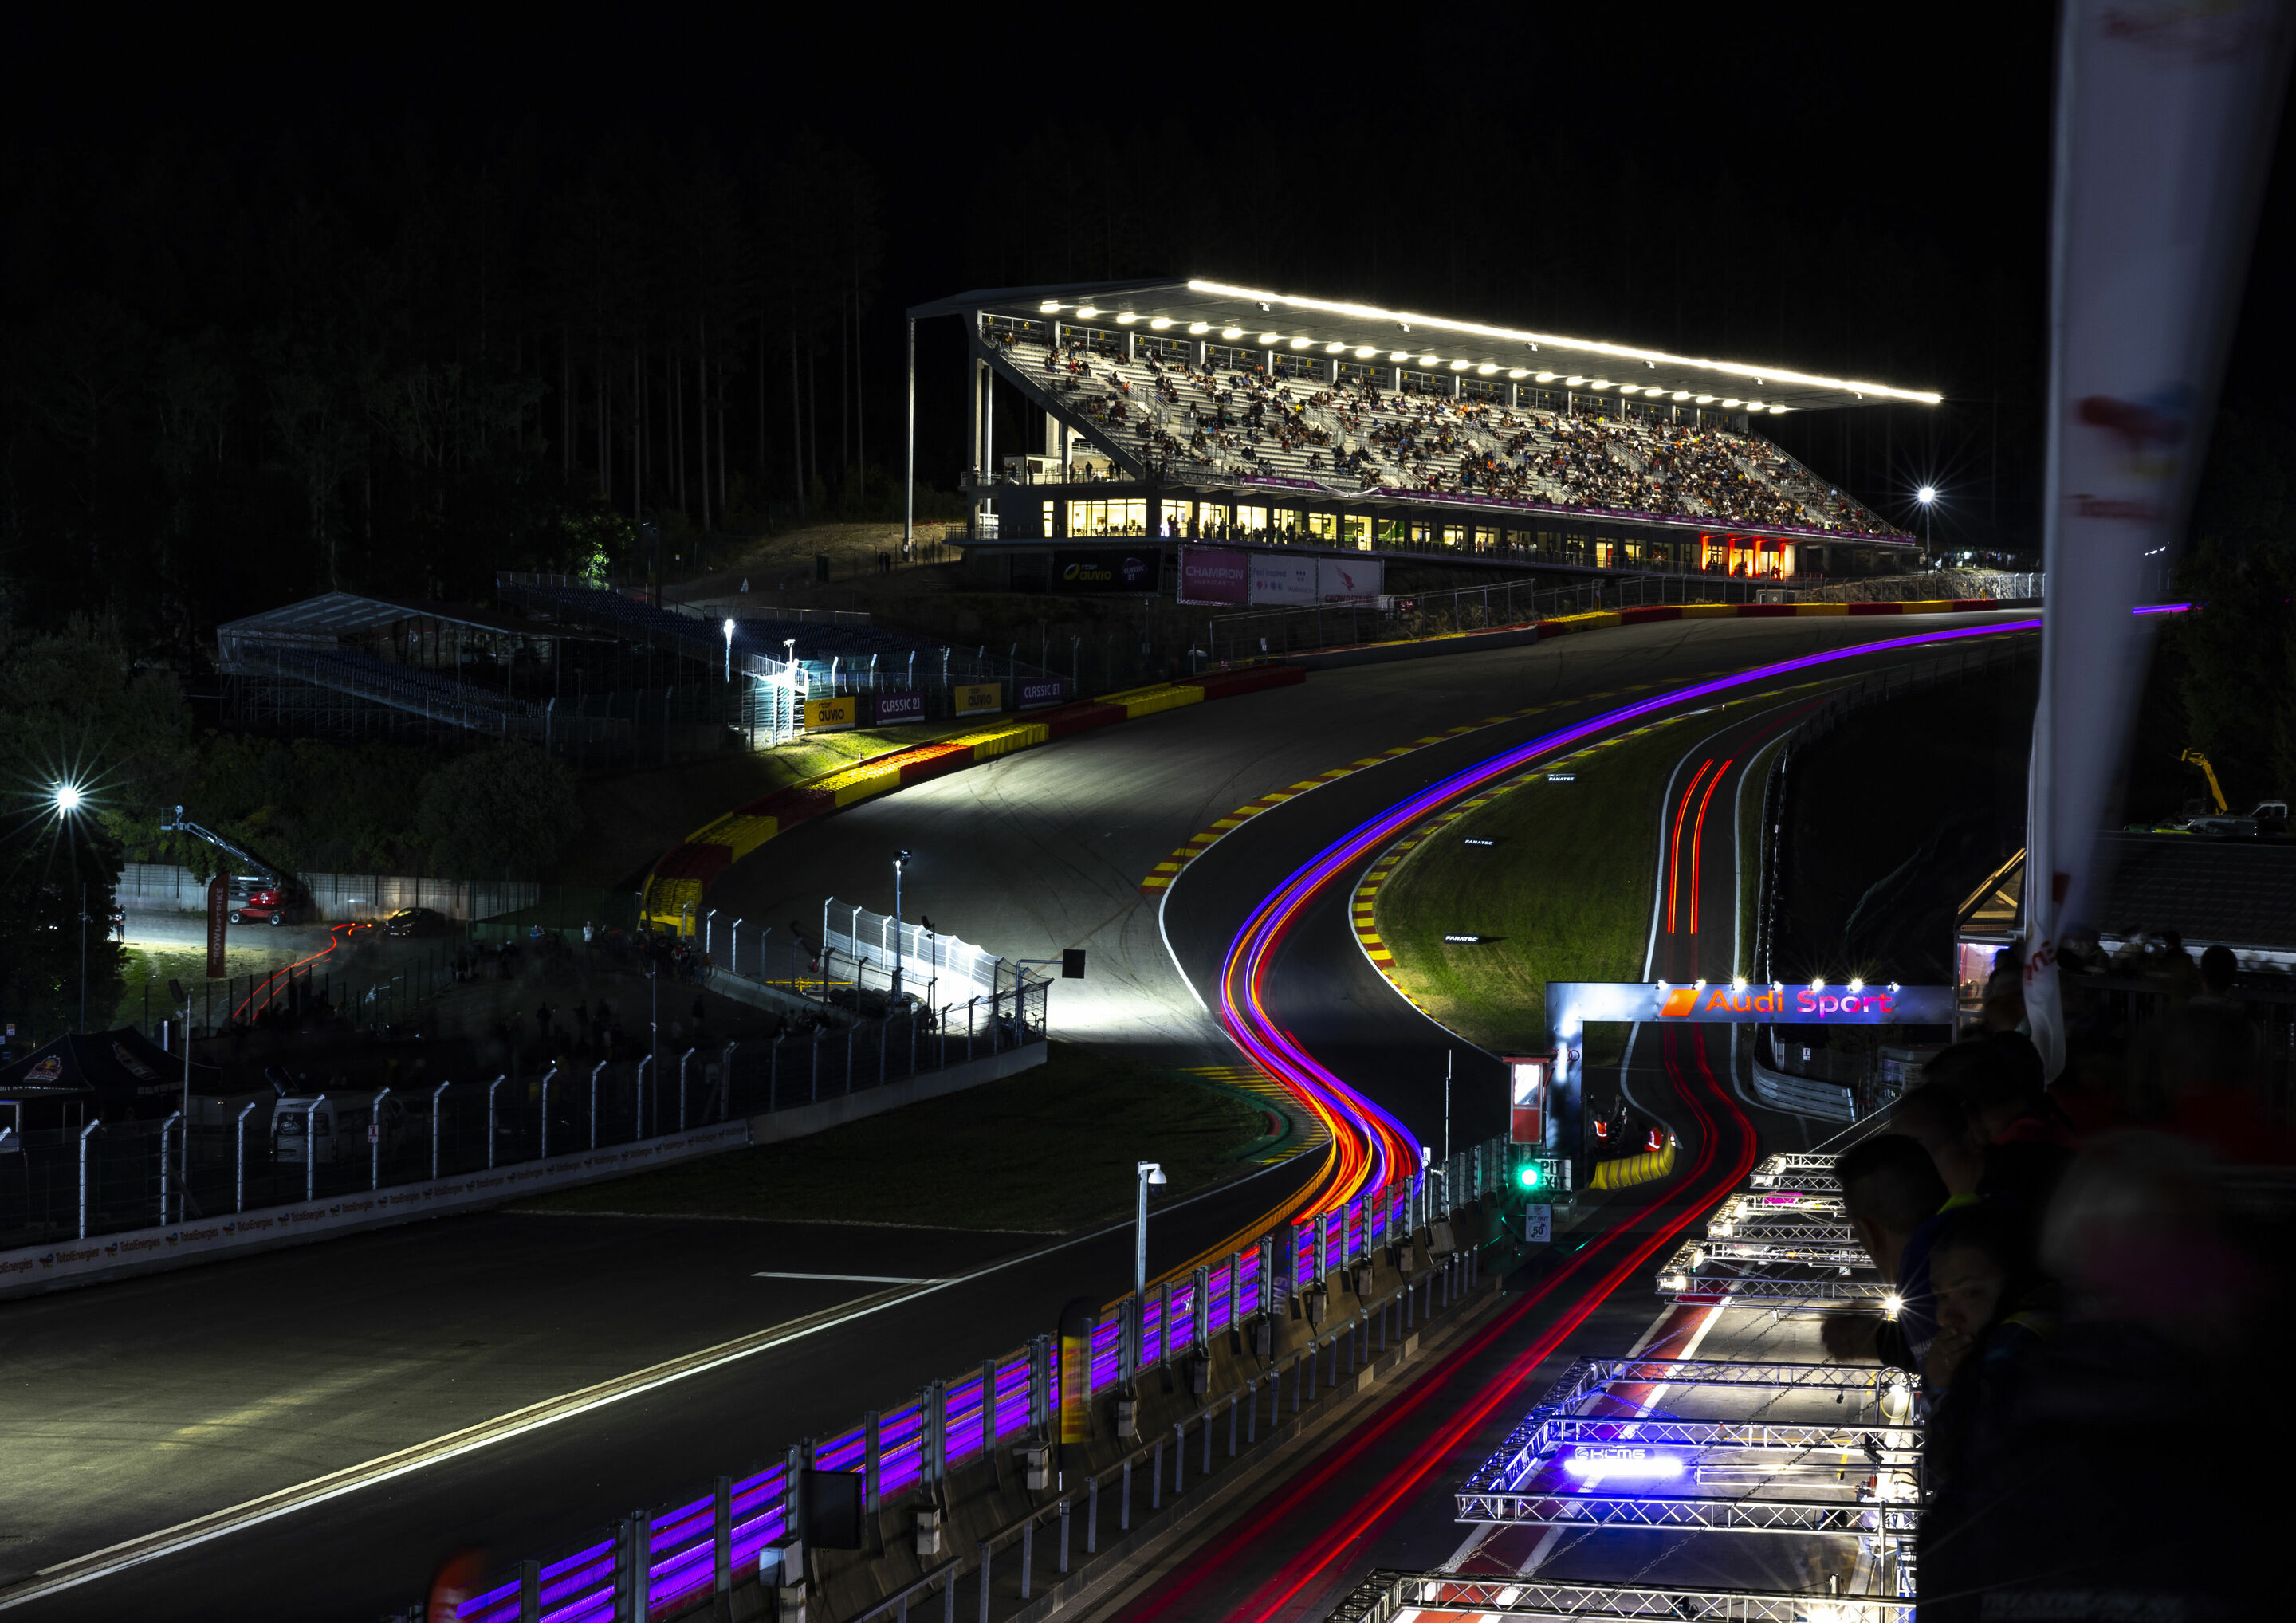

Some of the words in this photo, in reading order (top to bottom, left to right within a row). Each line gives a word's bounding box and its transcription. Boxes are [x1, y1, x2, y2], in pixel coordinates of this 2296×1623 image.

[1079, 570, 1112, 580] auvio
[1123, 565, 1144, 574] CLASSIC
[1185, 565, 1244, 580] CHAMPION
[1024, 684, 1051, 698] CLASSIC
[1052, 682, 1060, 696] 21
[881, 698, 911, 713] CLASSIC
[912, 698, 920, 709] 21
[968, 694, 992, 706] auvio
[819, 709, 844, 721] auvio
[1705, 989, 1784, 1012] Audi
[1797, 990, 1893, 1019] Sport
[1540, 1161, 1563, 1174] PIT
[291, 1208, 325, 1224] TotalEnergies
[237, 1216, 273, 1232] TotalEnergies
[1533, 1226, 1543, 1235] 50
[180, 1227, 219, 1243] TotalEnergies
[120, 1236, 160, 1254] TotalEnergies
[56, 1247, 100, 1264] TotalEnergies
